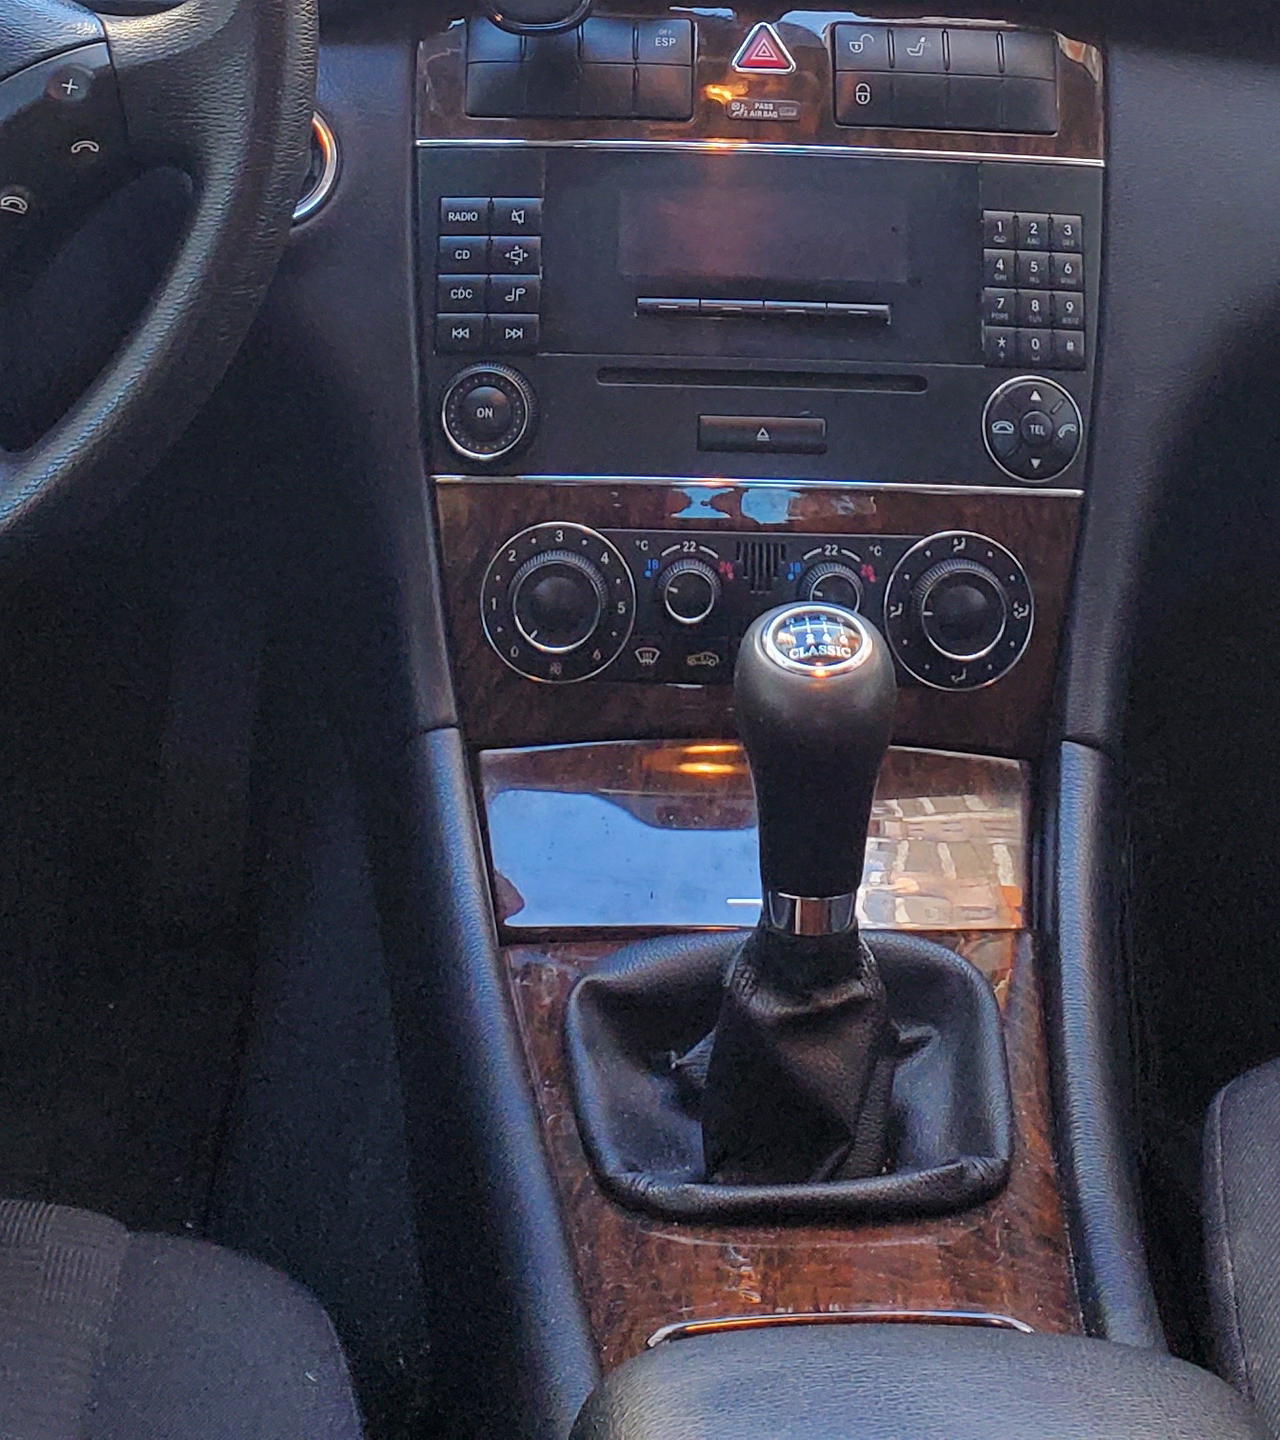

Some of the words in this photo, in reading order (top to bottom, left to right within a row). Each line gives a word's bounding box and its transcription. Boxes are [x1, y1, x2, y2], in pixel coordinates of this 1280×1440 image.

[655, 37, 677, 47] ESP
[448, 211, 478, 222] RADIO
[997, 220, 1003, 233] 1
[1029, 222, 1038, 235] 2
[1063, 224, 1072, 236] 3
[455, 249, 471, 260] CD
[995, 258, 1004, 271] 4
[1030, 260, 1039, 273] 5
[1064, 262, 1073, 274] 6
[450, 288, 473, 299] CDC
[996, 297, 1005, 309] 7
[1031, 299, 1040, 312] 8
[1065, 301, 1074, 313] 9
[476, 407, 493, 418] ON
[1029, 423, 1046, 436] TEL
[555, 529, 564, 542] 3
[682, 540, 697, 553] 22
[824, 544, 839, 556] 22
[508, 549, 517, 562] 2
[600, 551, 610, 565] 4
[490, 597, 497, 610] 1
[617, 601, 626, 614] 5
[511, 646, 519, 657] 0
[592, 650, 602, 660] 6
[789, 645, 852, 659] CLASSIC
